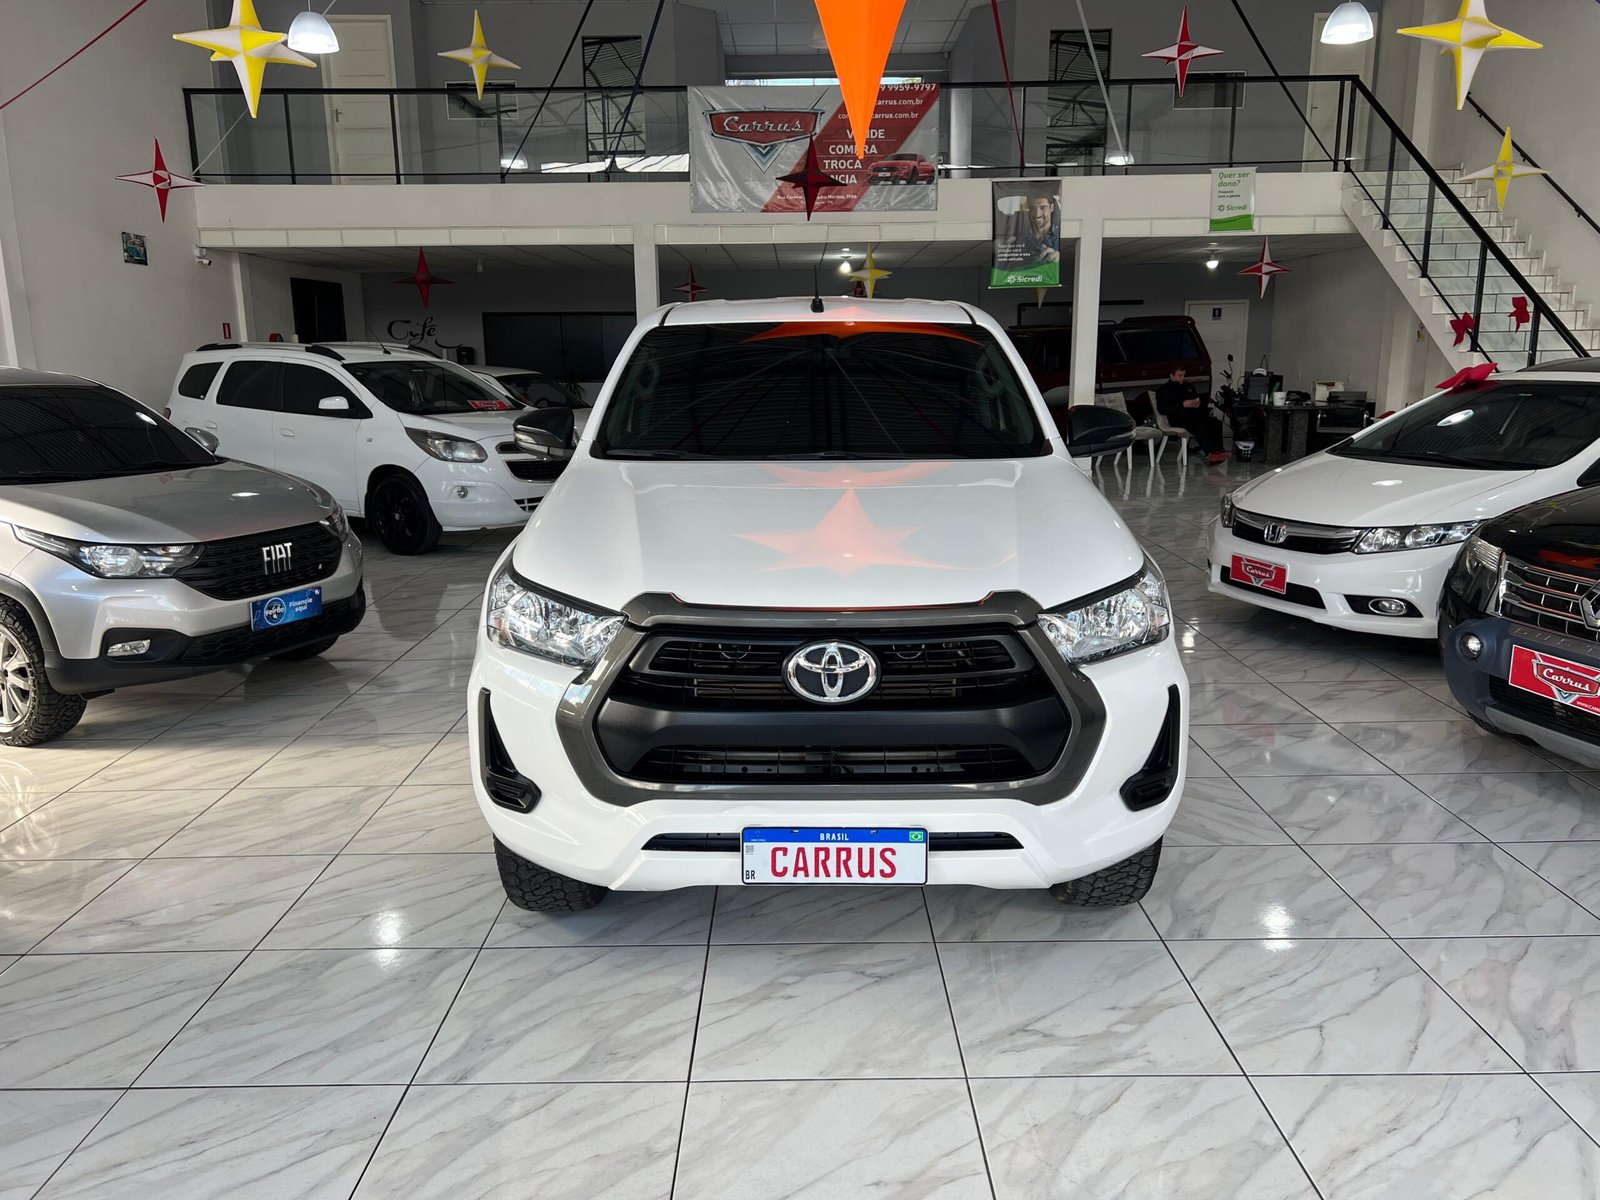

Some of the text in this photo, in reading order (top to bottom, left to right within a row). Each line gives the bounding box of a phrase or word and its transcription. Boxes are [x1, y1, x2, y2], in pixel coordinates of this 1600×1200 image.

[723, 116, 803, 132] Carrus
[823, 159, 862, 169] TROCA
[1218, 171, 1236, 180] Quer
[1217, 179, 1241, 188] dono?
[1017, 275, 1043, 283] Sicredi
[262, 542, 293, 575] FIAT
[289, 597, 313, 608] Financie
[1543, 668, 1591, 692] Carrus
[819, 832, 849, 841] BRASIL
[770, 847, 897, 878] CARRUS
[745, 869, 756, 880] BR
